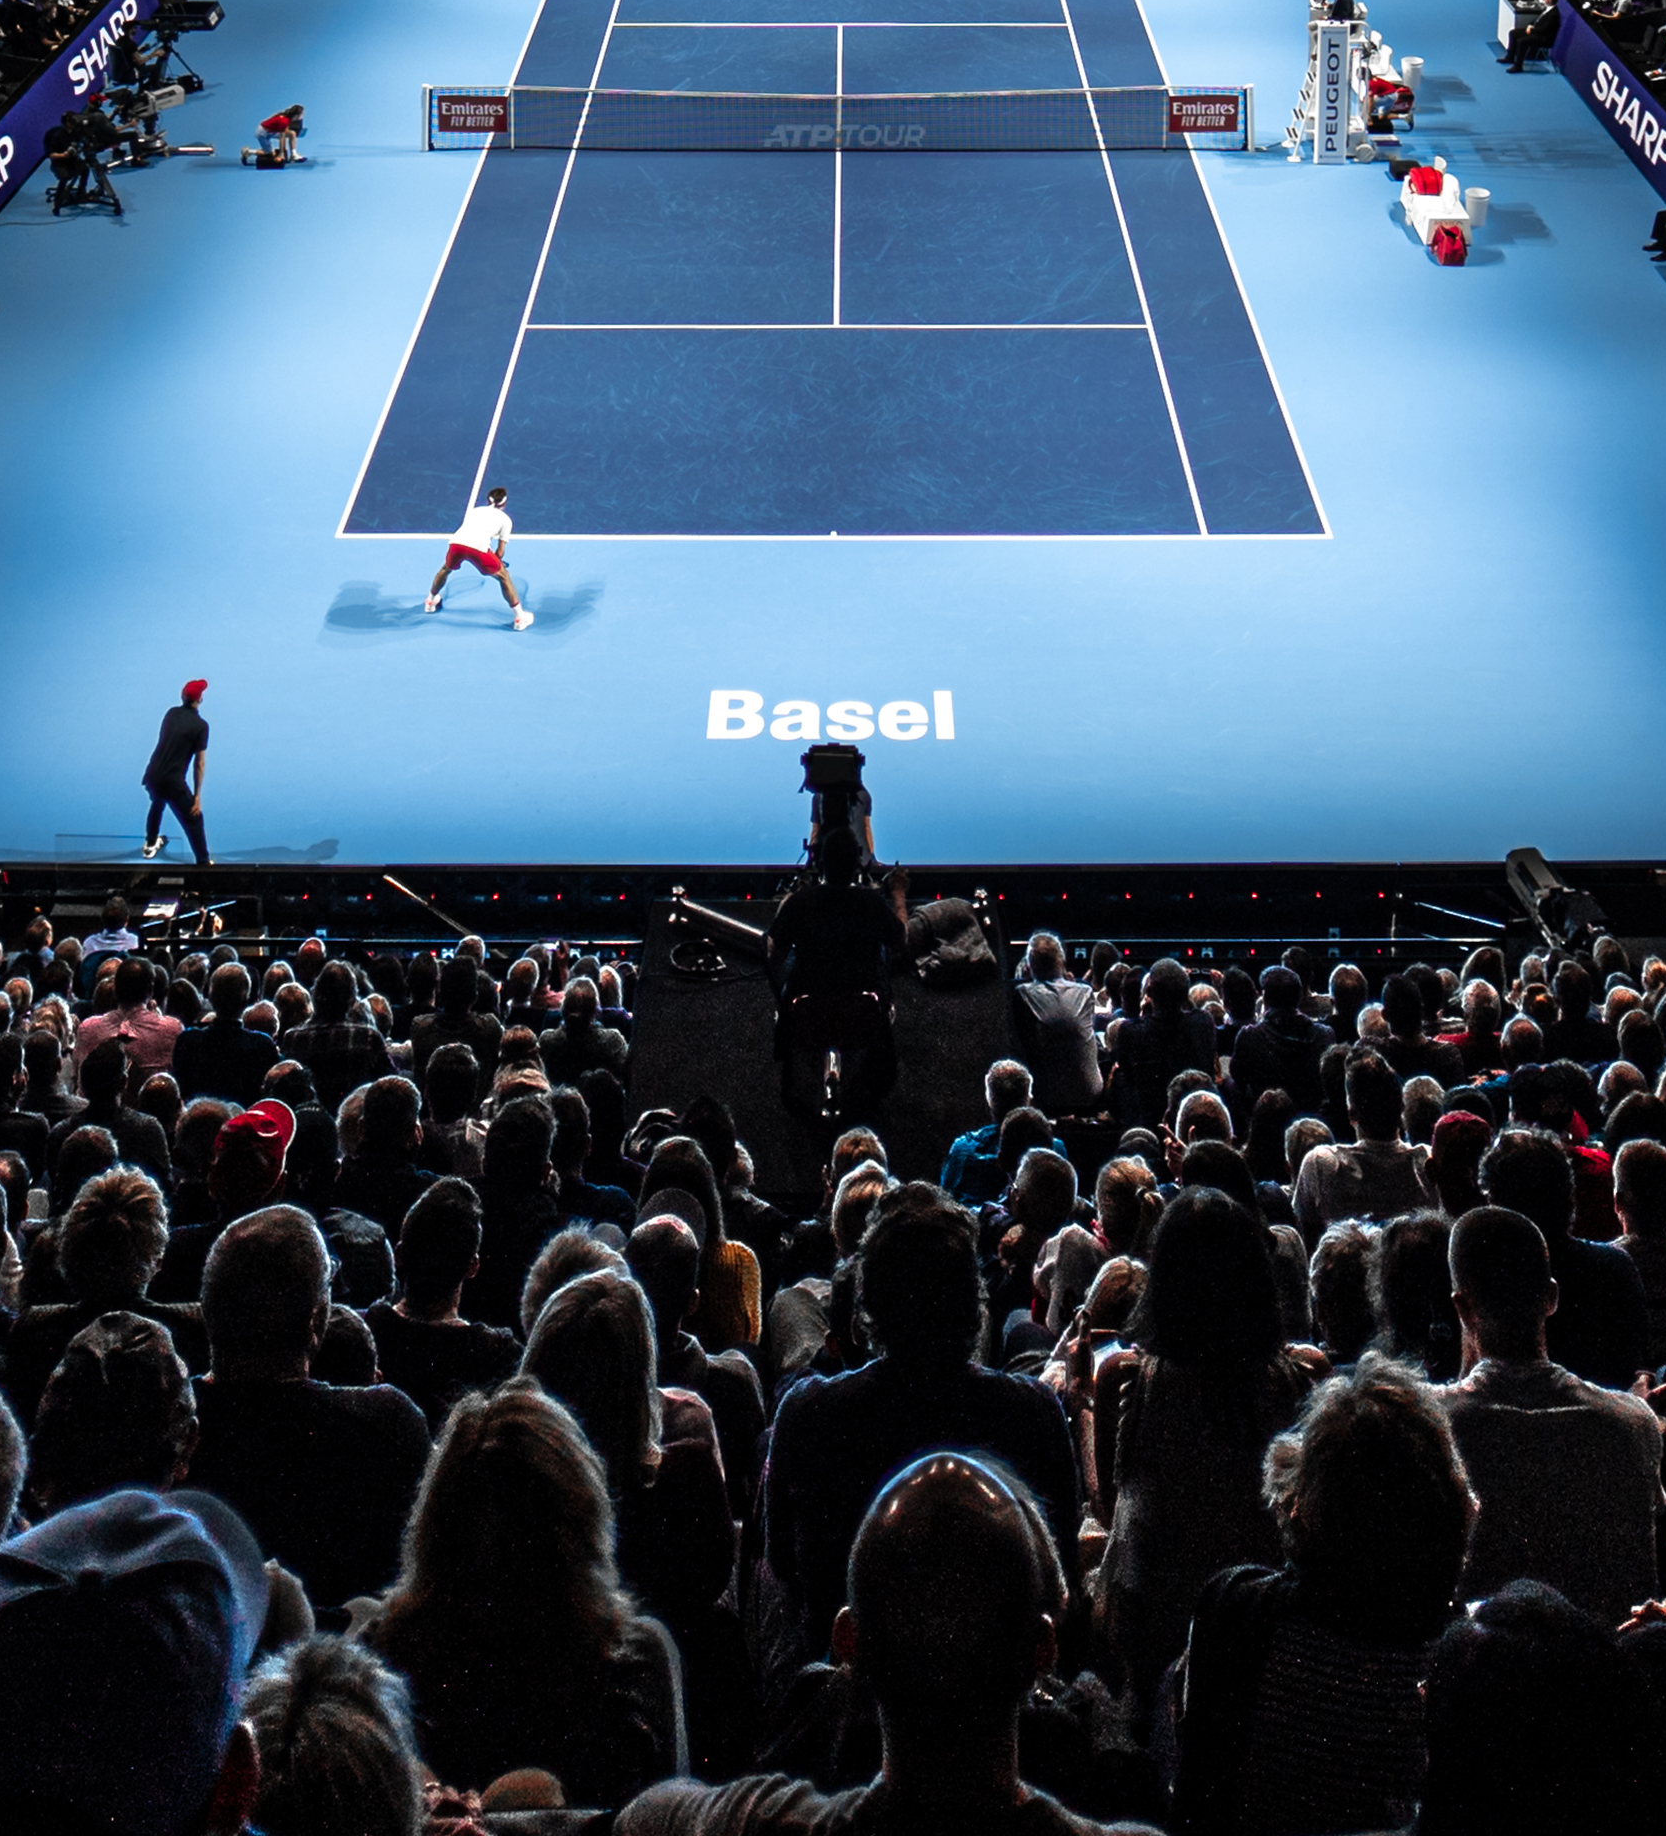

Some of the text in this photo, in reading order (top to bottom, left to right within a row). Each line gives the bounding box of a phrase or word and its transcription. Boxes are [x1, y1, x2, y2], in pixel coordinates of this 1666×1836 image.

[1324, 37, 1341, 153] PEUGEOT
[440, 101, 504, 116] Emirates
[1172, 101, 1236, 116] Emirates
[450, 116, 495, 127] FLY BETTER
[1180, 115, 1226, 127] FLY BETTER
[763, 123, 926, 148] ATP TOUR
[706, 689, 955, 741] Basel
